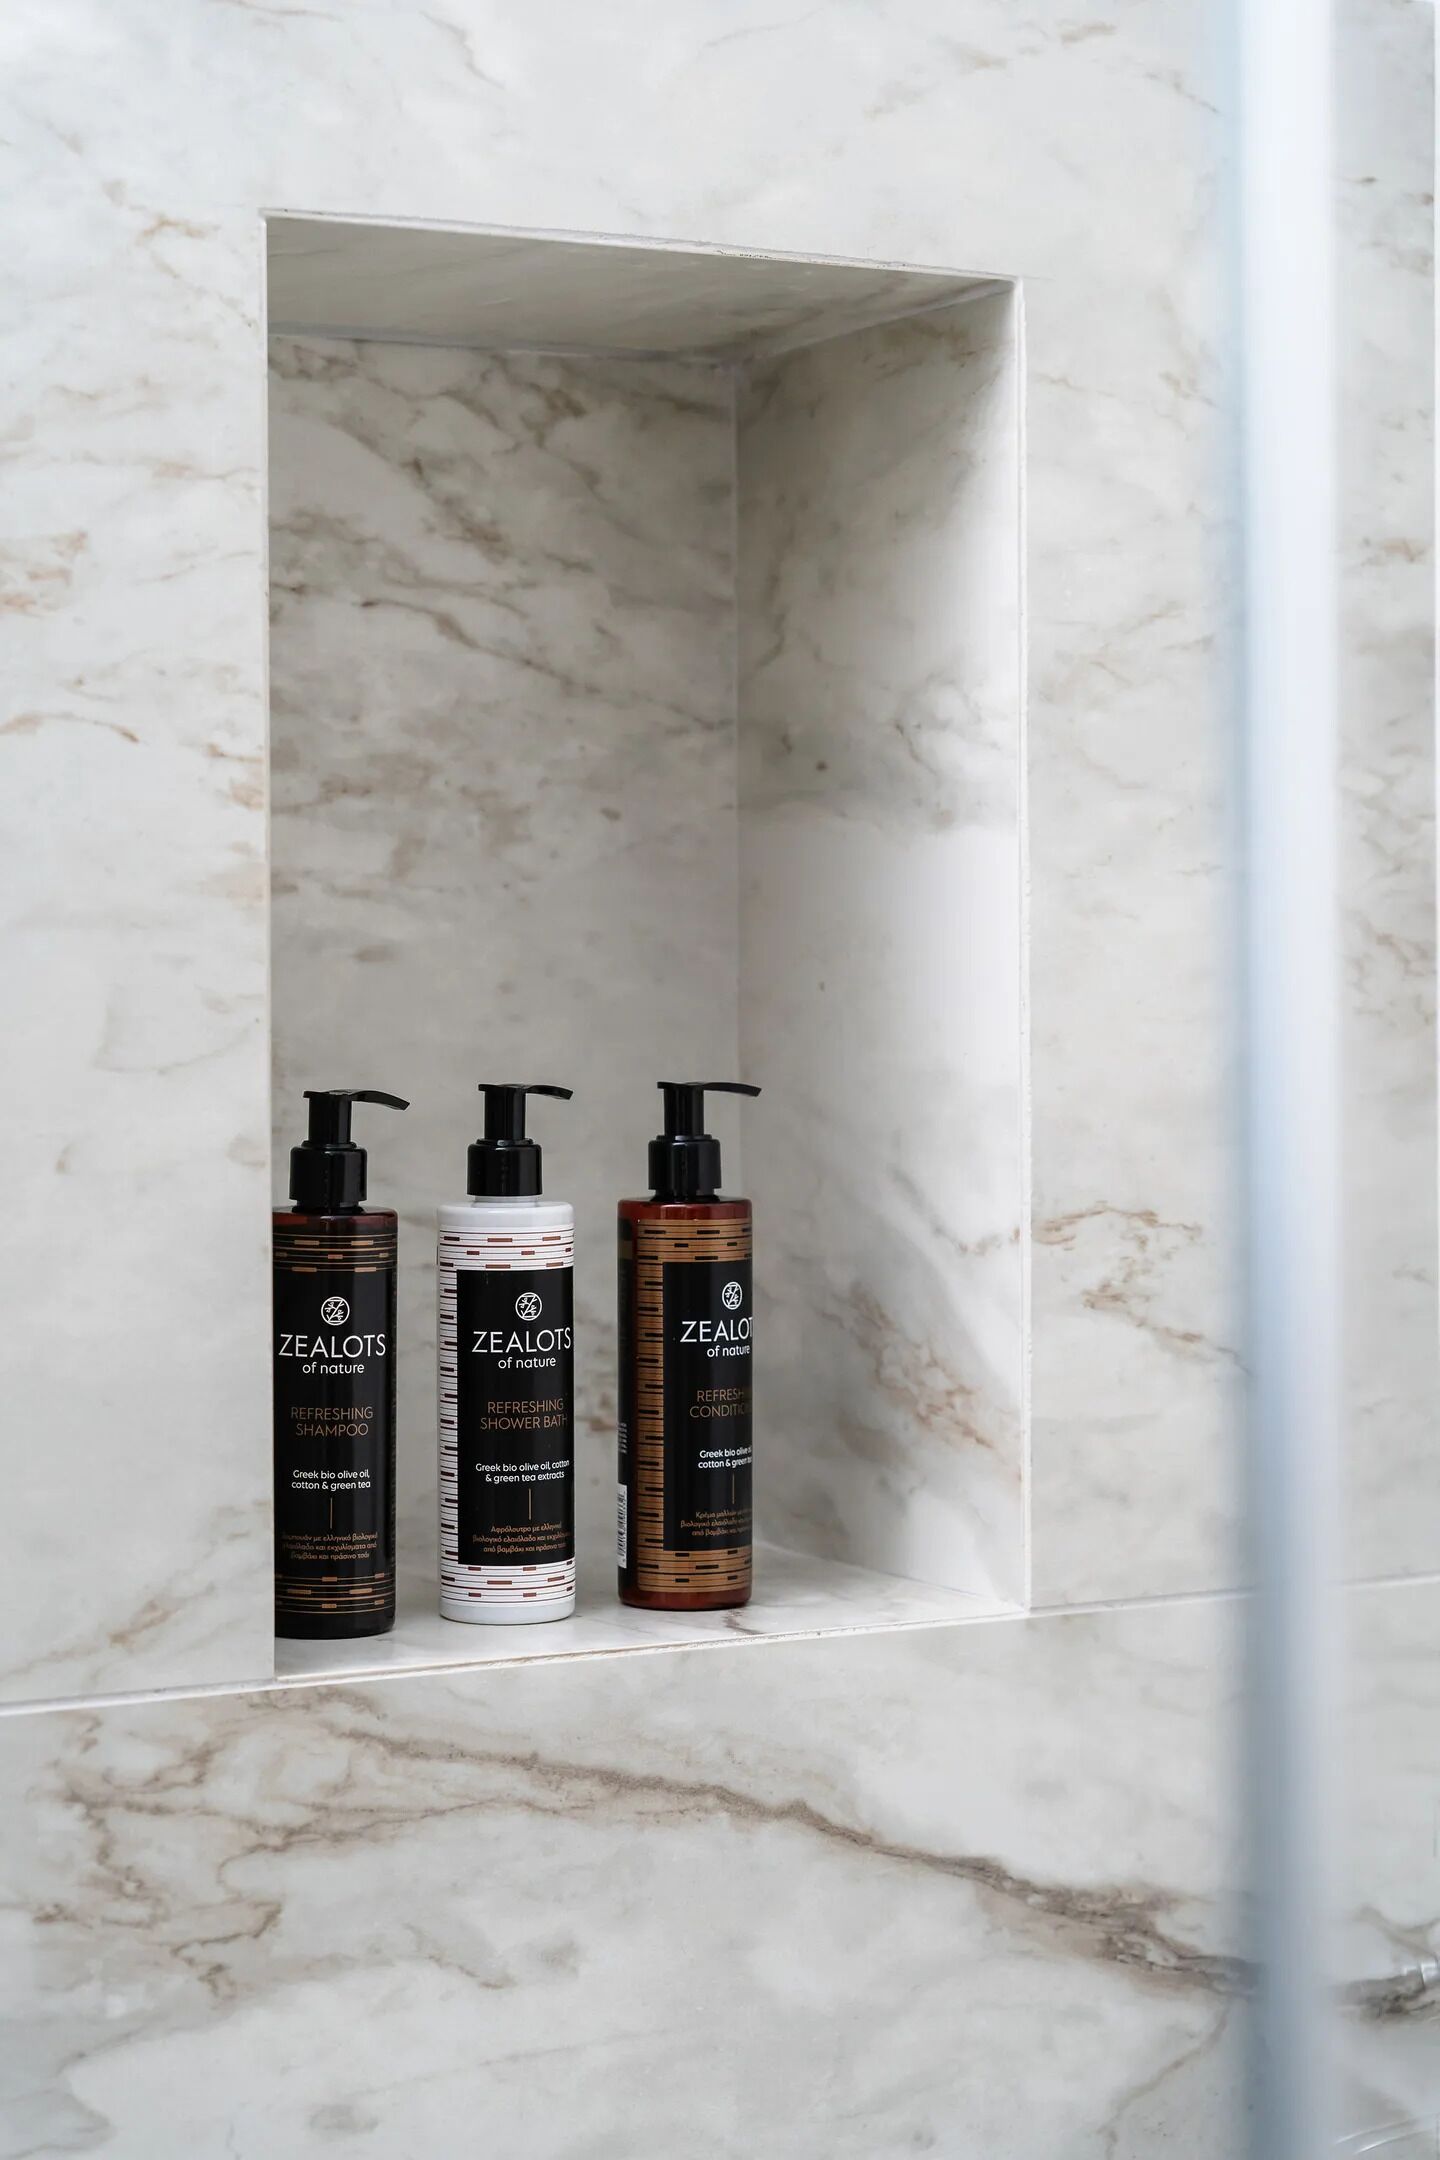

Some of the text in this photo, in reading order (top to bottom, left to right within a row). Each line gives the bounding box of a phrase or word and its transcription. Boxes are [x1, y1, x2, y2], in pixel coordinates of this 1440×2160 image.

[680, 1316, 753, 1343] ZEALOT
[278, 1333, 386, 1358] ZEALOTS
[471, 1327, 572, 1353] ZEALOTS
[707, 1345, 750, 1358] of nature
[302, 1361, 365, 1374] of nature
[498, 1357, 556, 1369] of nature
[487, 1398, 564, 1414] REFRESHING
[290, 1406, 374, 1421] REFRESHING
[480, 1415, 567, 1430] SHOWER BATH
[295, 1423, 369, 1437] SHAMPOO
[699, 1449, 724, 1459] Greek
[724, 1448, 736, 1457] bio
[475, 1463, 501, 1472] Greek
[502, 1463, 518, 1472] bio
[519, 1462, 539, 1472] olive
[551, 1459, 570, 1470] cotton
[698, 1460, 725, 1469] cotton
[725, 1458, 731, 1467] &
[292, 1469, 319, 1479] Greek
[320, 1469, 336, 1479] bio
[337, 1469, 358, 1479] olive
[485, 1471, 565, 1484] & green tea extracts
[291, 1480, 371, 1492] cotton & green tea
